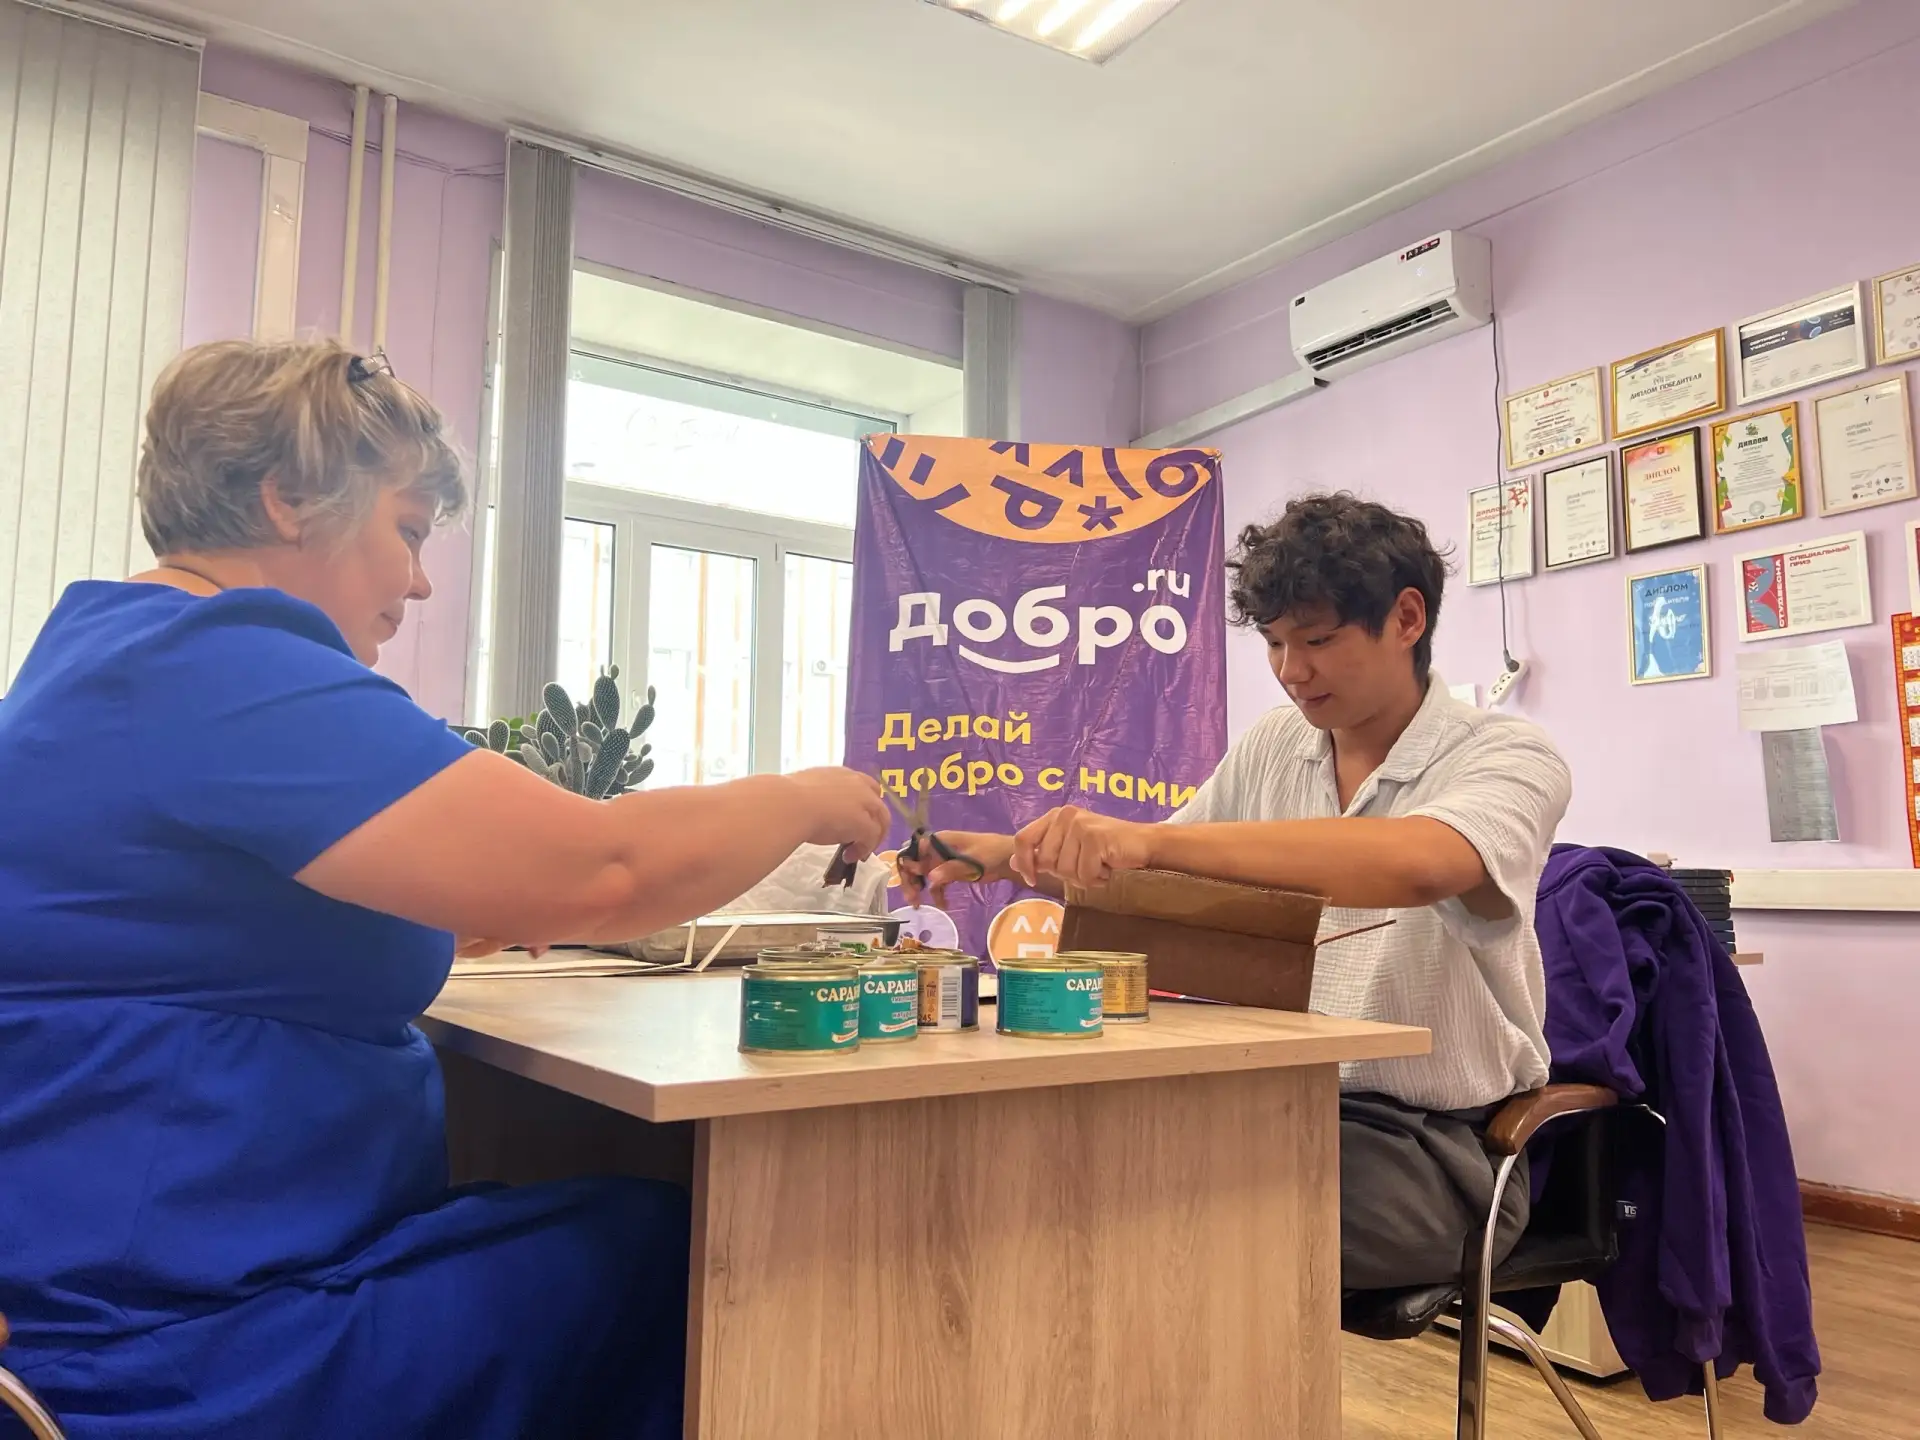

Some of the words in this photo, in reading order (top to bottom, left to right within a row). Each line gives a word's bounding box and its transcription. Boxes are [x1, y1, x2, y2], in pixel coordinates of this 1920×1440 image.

[1630, 386, 1658, 401] ДИПЛОМ
[1659, 372, 1702, 391] ПОБЕДИТЕЛЯ
[1737, 435, 1769, 450] ДИПЛОМ
[1643, 464, 1681, 482] ДИПЛОМ
[1789, 544, 1851, 561] СПЕЦИАЛЬНЫЙ
[1790, 559, 1811, 567] ПРИЗ
[1132, 568, 1191, 599] .ru
[1644, 583, 1689, 598] ДИПЛОМ
[878, 711, 1032, 751] Делай
[880, 753, 1024, 797] добро
[1037, 767, 1065, 791] с
[1079, 766, 1198, 808] нами
